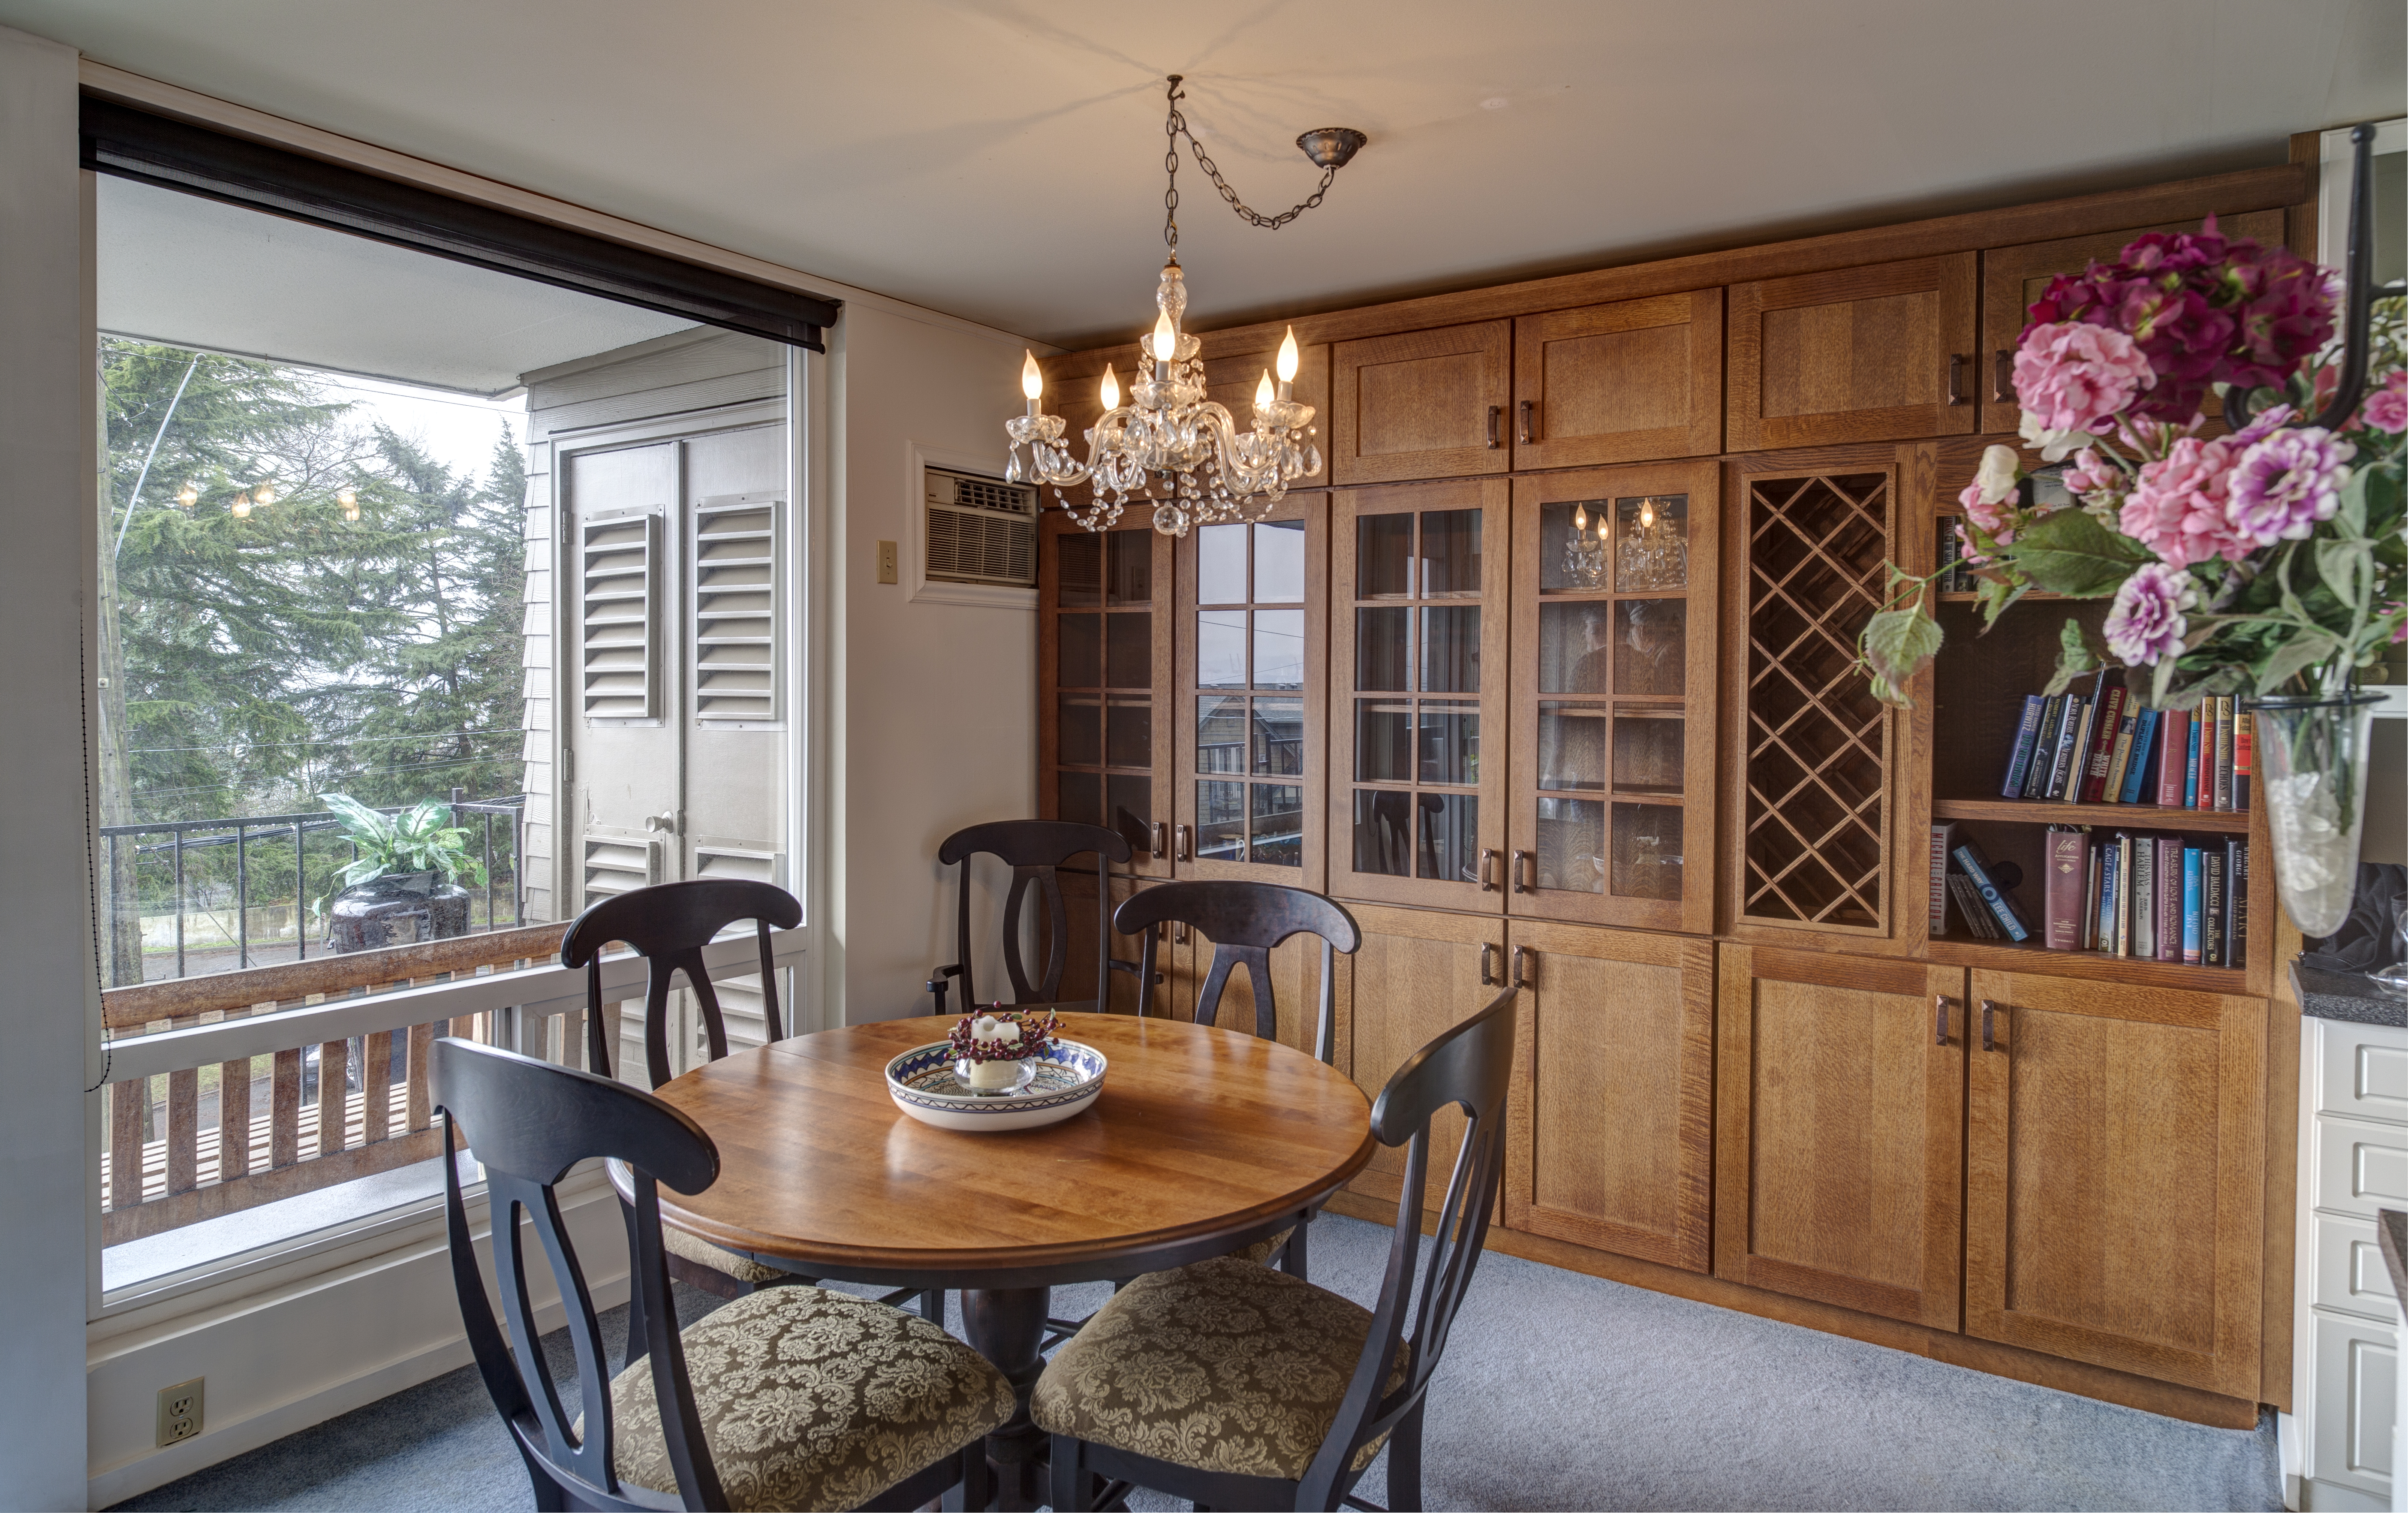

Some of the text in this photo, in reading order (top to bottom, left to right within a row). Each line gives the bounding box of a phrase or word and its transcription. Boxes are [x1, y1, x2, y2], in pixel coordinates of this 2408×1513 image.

[1944, 517, 1953, 534] ERMAN
[2022, 703, 2037, 732] HURWITZ
[2052, 699, 2060, 718] ROBERT
[2066, 703, 2080, 734] NORA ROBERTS
[2101, 690, 2121, 740] CLIVE CUSSLER
[2130, 720, 2147, 775] DUPLICATE BRIDGE
[2204, 727, 2213, 755] DANIELLE STEEL
[2219, 724, 2230, 761] DANIELLE STEEL
[2009, 734, 2032, 787] DO NO HARM
[2054, 747, 2071, 784] NORTHERN LIGHTS
[2089, 753, 2101, 776] DEATH
[2099, 755, 2110, 778] WHITE
[2115, 748, 2125, 769] Perfect
[2188, 758, 2197, 780] MIRACLE
[2219, 765, 2230, 790] ECHOES
[1931, 833, 1944, 869] MICHAEL
[2056, 840, 2076, 854] life
[1963, 859, 1975, 873] HARD
[1972, 871, 1984, 884] WAY
[2170, 847, 2179, 879] TREASURY
[2103, 872, 2111, 893] STARS
[2170, 886, 2178, 902] LOVE
[2209, 856, 2220, 906] DAVID BALDACCI
[1929, 877, 1942, 920] CRICHTON
[1992, 902, 2001, 914] LEE
[2000, 913, 2016, 931] CHILD
[2169, 915, 2177, 945] ROMANCE
